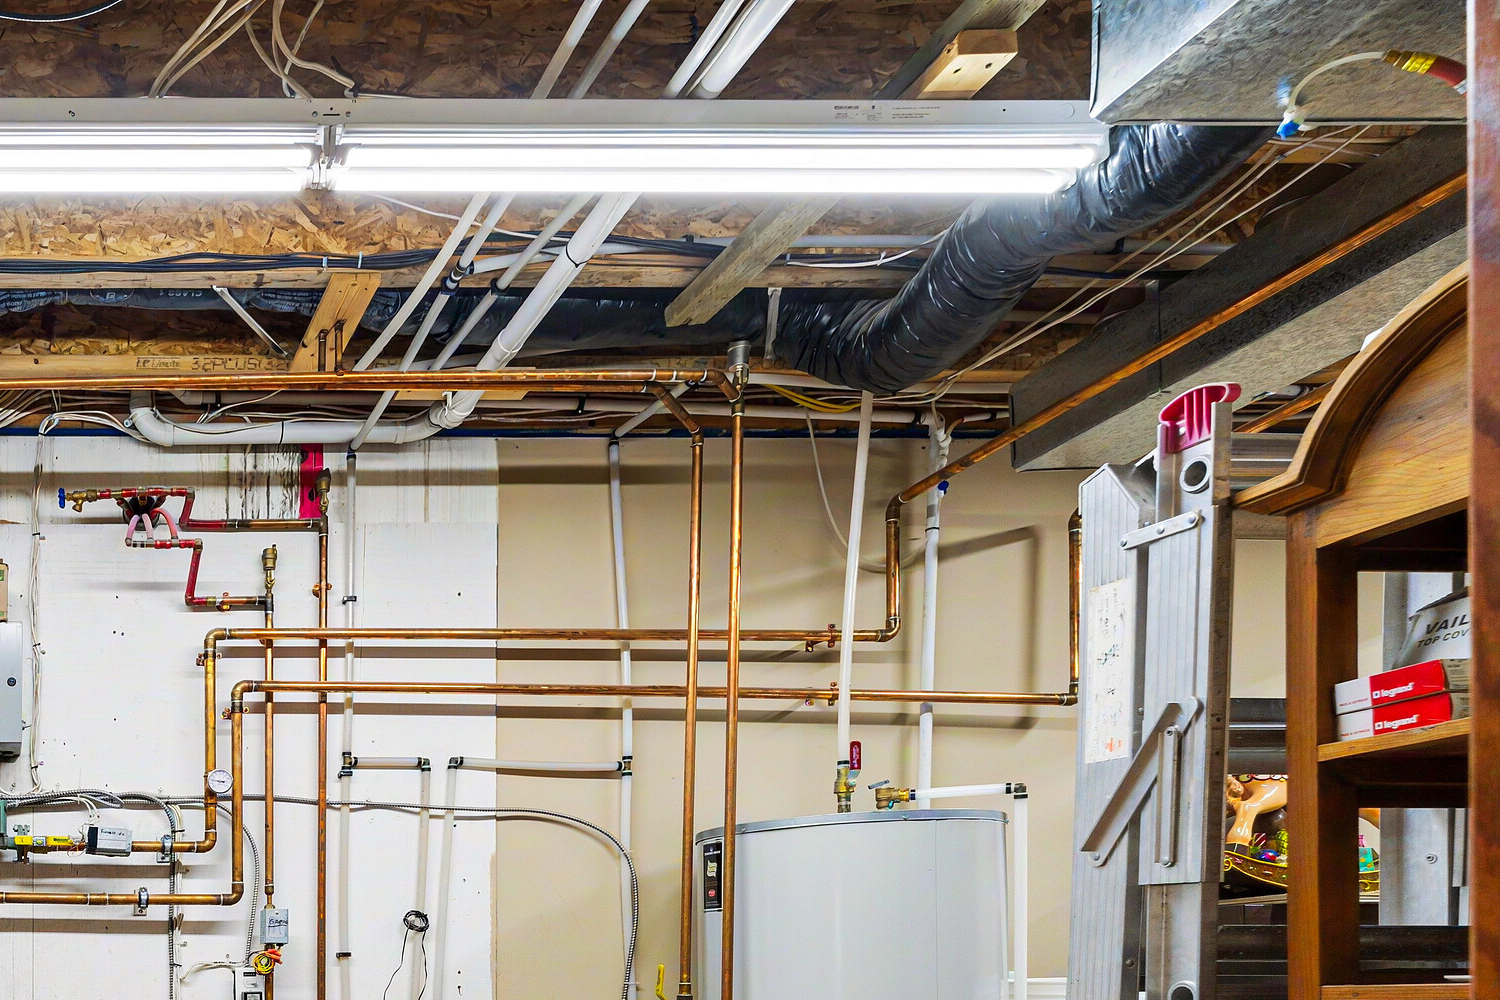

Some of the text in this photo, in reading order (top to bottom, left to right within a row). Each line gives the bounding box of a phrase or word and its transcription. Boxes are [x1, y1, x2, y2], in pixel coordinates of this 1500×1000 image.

[1426, 613, 1470, 635] VAIL
[1417, 635, 1441, 648] TOP
[1381, 682, 1414, 698] legrand
[1384, 714, 1418, 729] legrand
